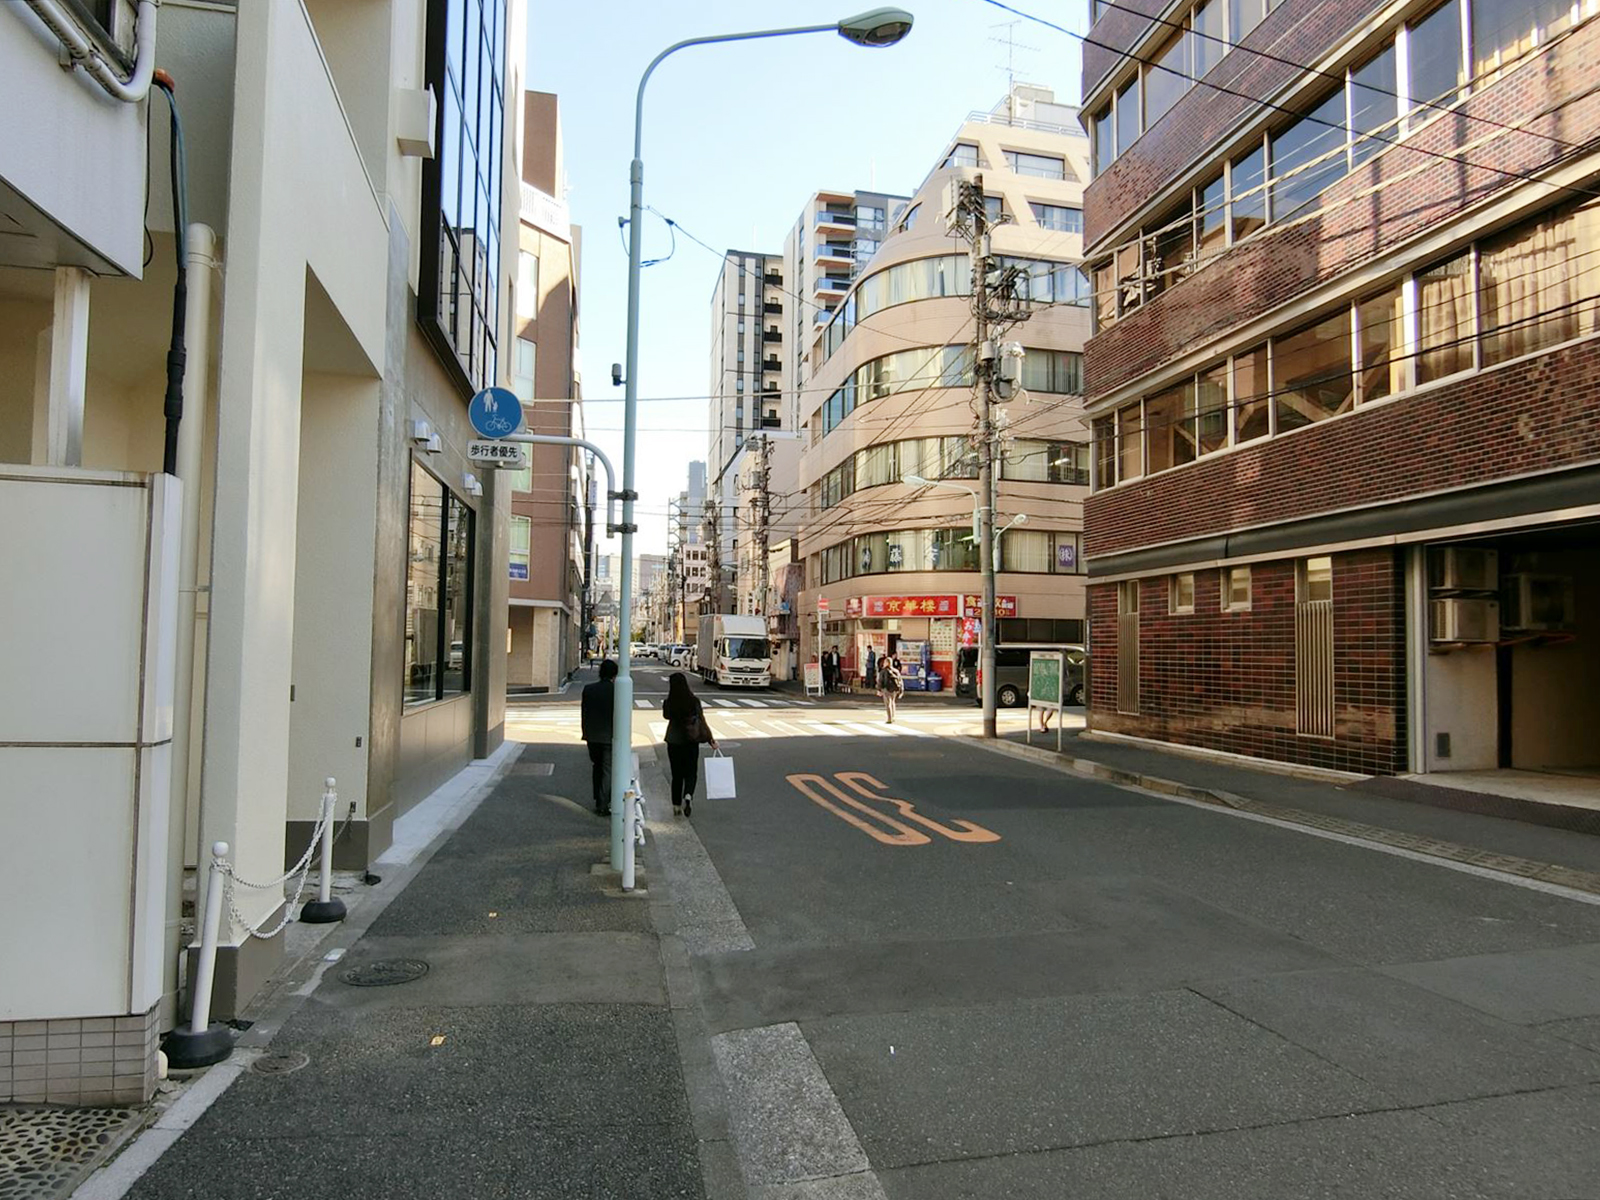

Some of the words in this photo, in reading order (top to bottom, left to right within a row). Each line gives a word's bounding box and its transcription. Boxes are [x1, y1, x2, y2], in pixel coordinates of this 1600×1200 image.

[471, 445, 518, 458] 歩行者優先
